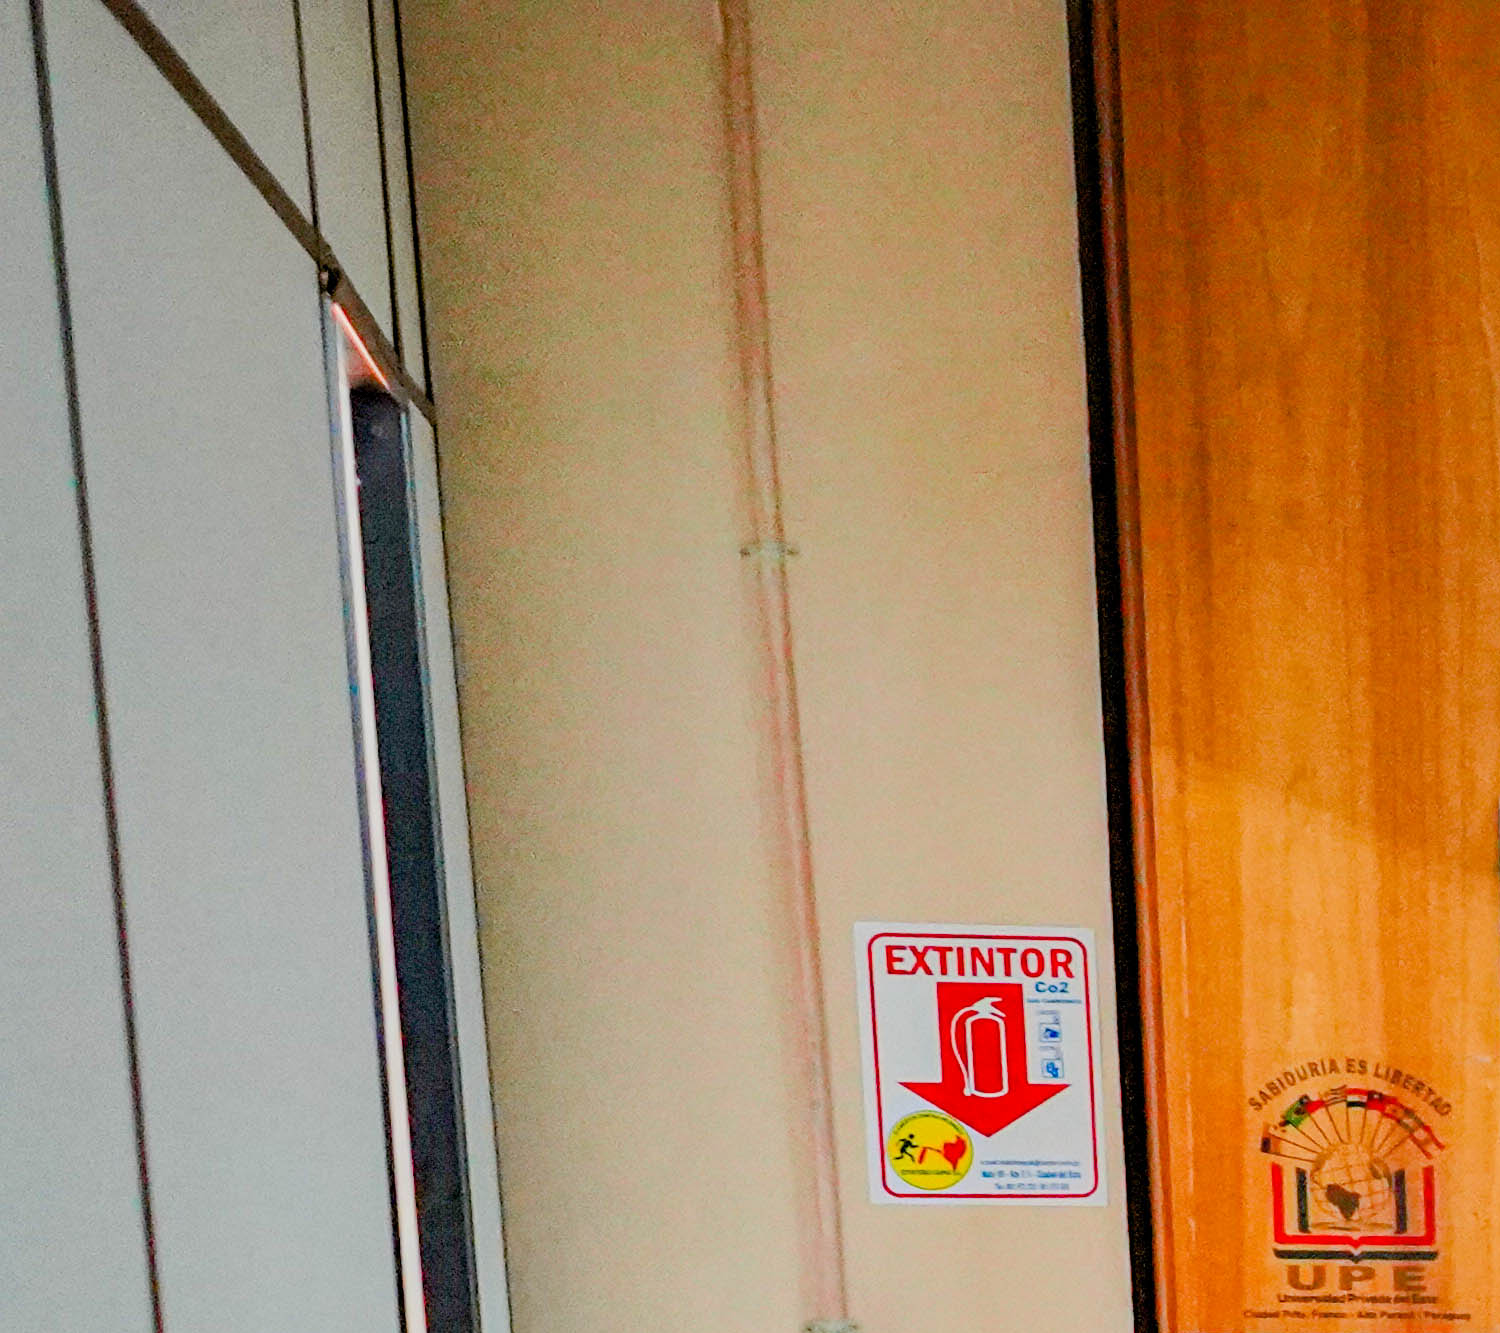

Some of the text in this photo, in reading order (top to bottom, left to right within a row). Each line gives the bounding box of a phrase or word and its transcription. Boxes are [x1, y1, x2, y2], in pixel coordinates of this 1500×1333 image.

[885, 945, 1075, 978] EXTINTOR
[1345, 1058, 1368, 1075] ES
[1372, 1061, 1453, 1116] LIBERTAD
[1287, 1264, 1427, 1292] UPE
